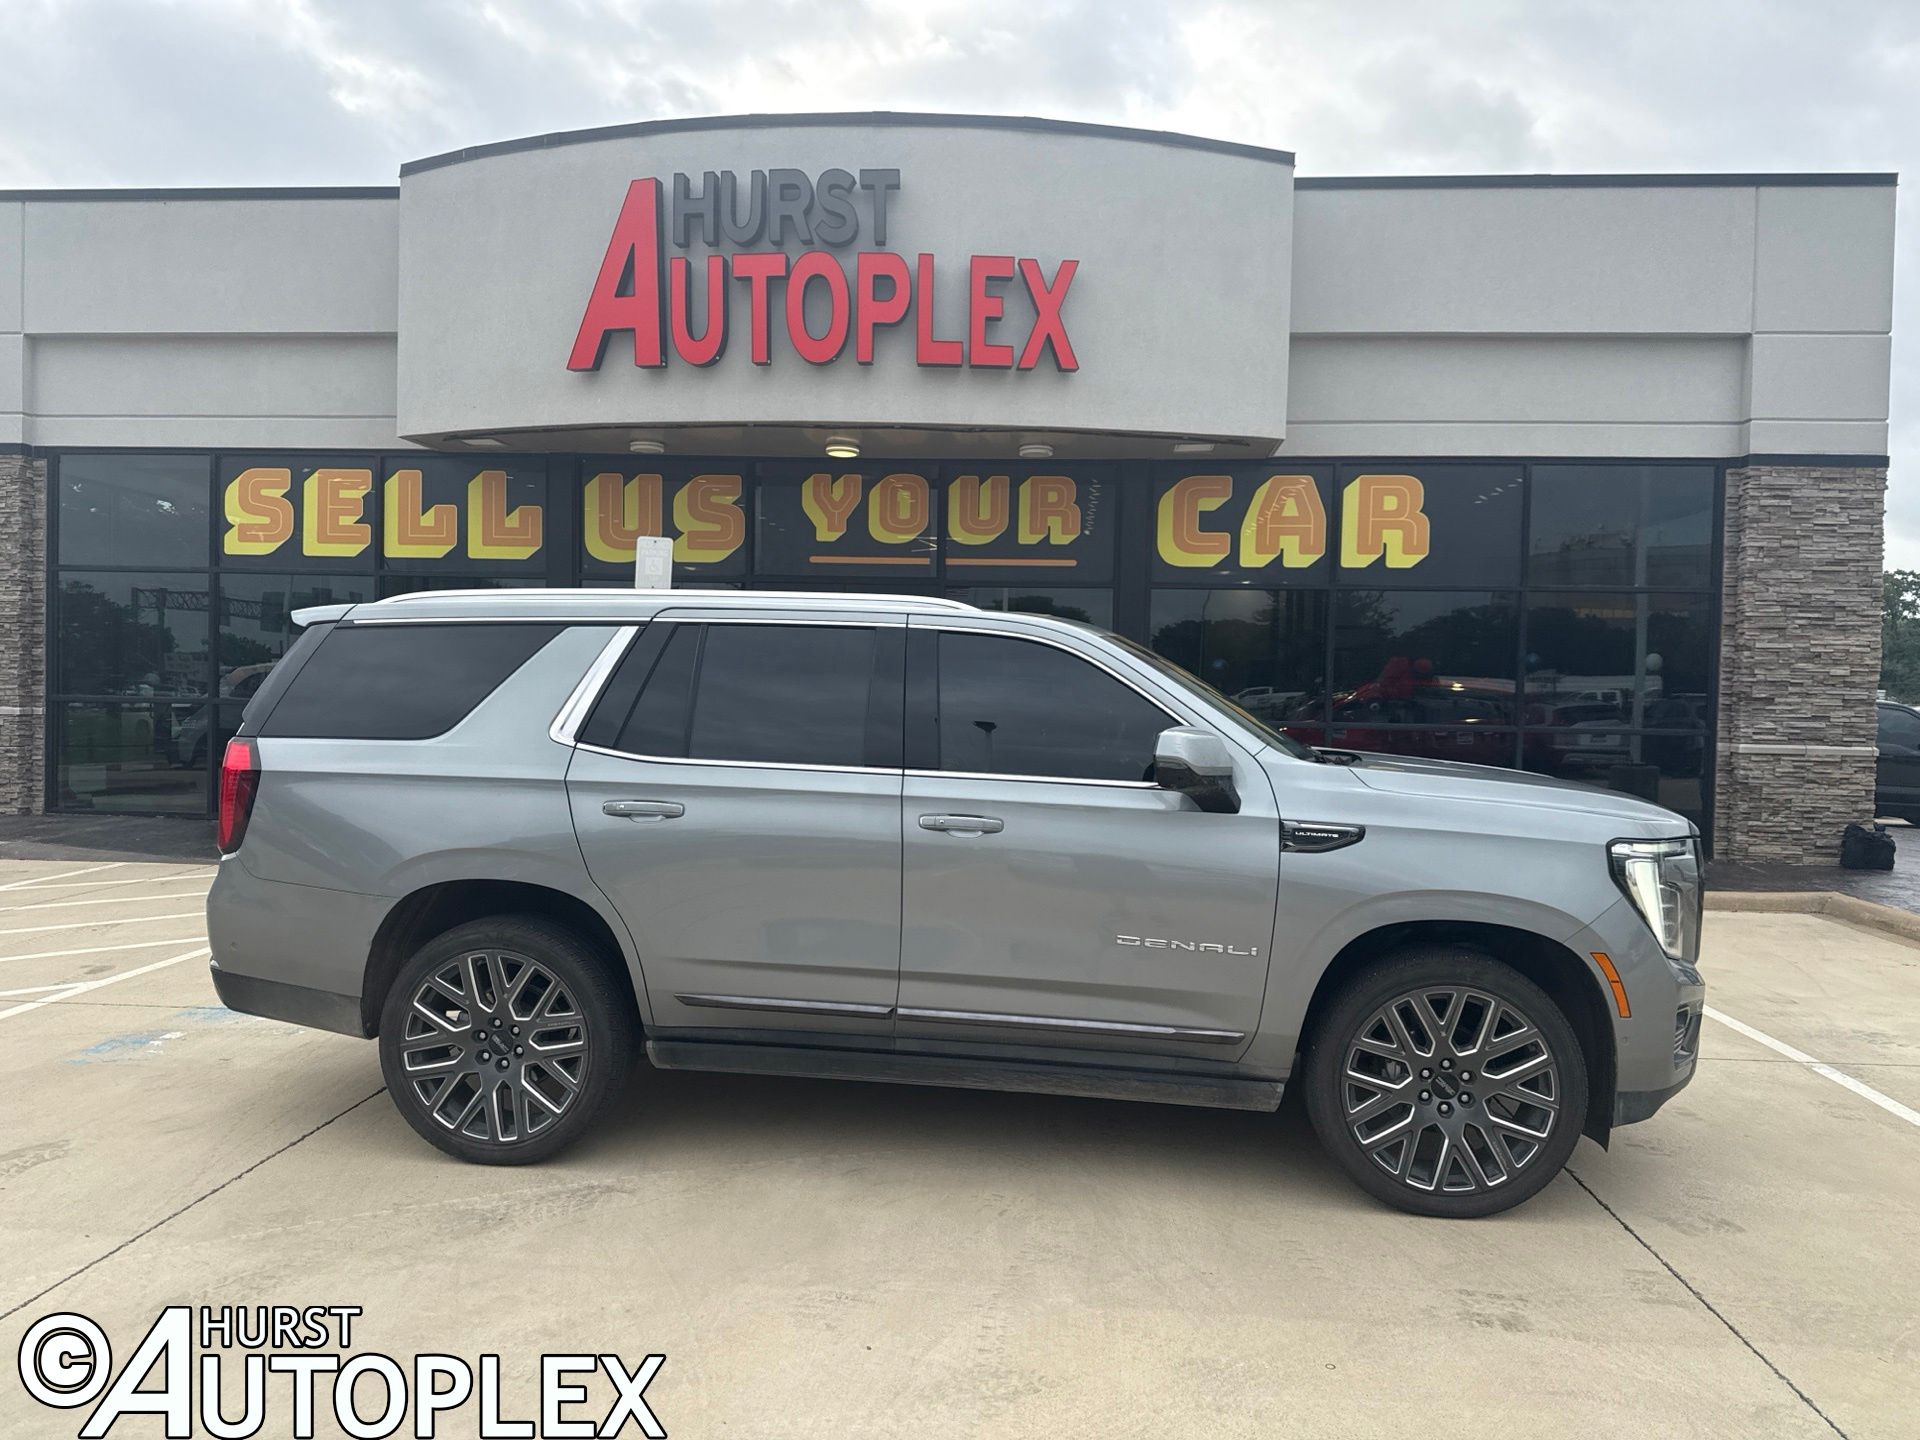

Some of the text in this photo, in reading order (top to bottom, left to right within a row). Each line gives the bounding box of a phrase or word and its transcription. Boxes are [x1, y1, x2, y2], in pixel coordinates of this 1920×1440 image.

[673, 168, 901, 249] HURST
[566, 177, 1080, 373] AUTOPLEX
[224, 468, 1430, 568] SELL US YOUR CAR
[1116, 934, 1258, 956] DENALI
